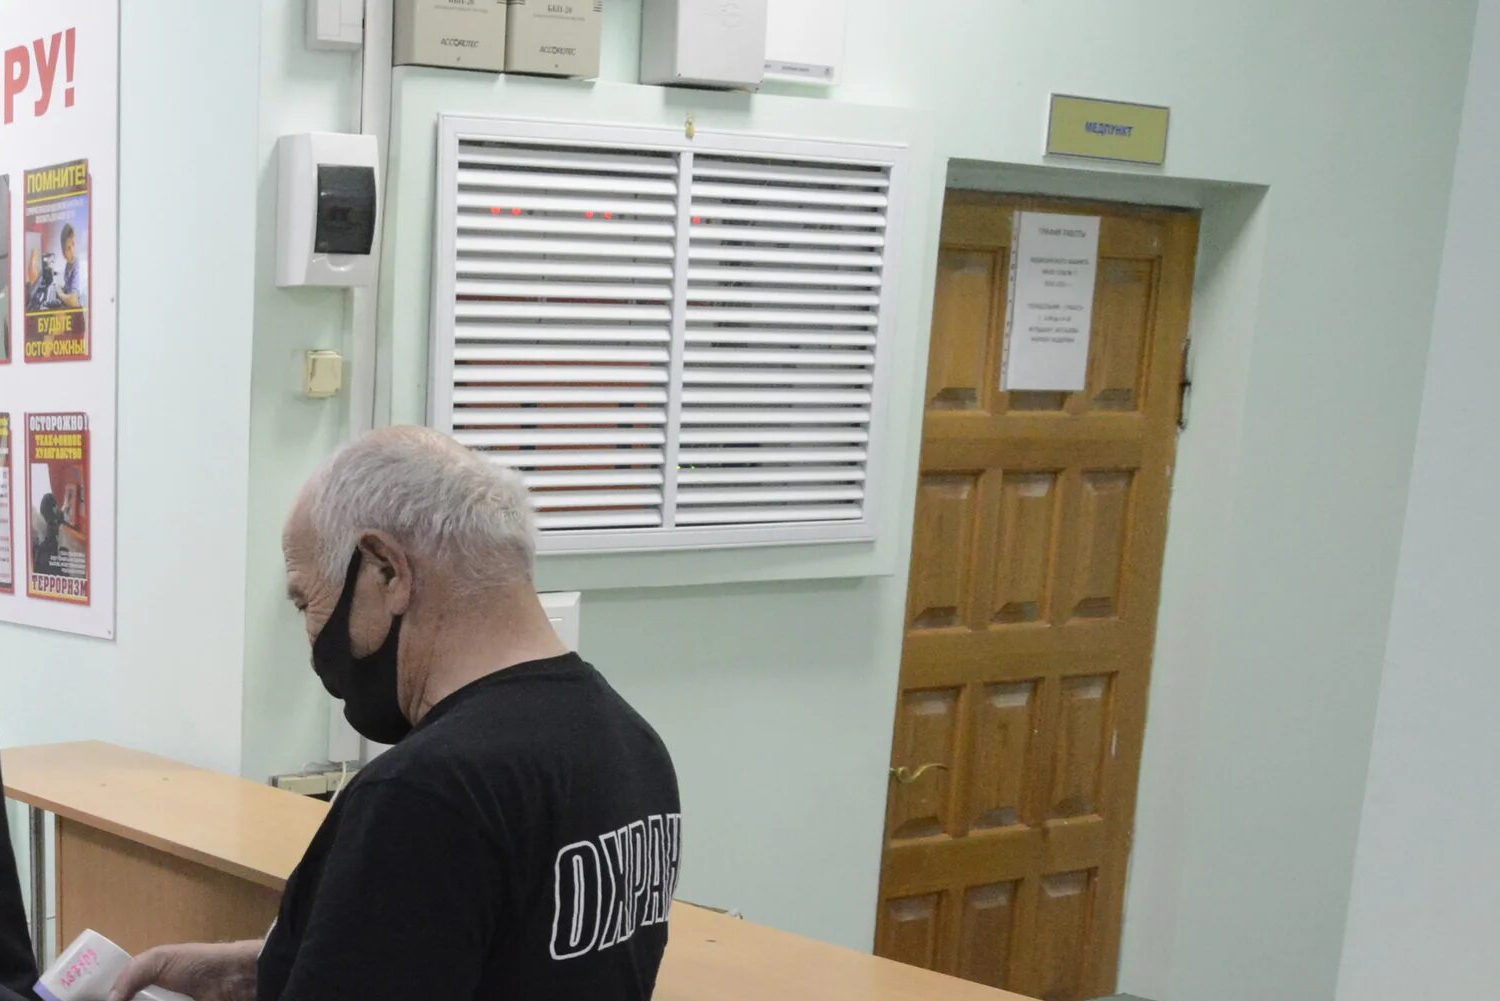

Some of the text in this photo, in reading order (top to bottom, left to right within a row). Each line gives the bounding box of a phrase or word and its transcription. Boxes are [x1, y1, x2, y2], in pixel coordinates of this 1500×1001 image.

[1085, 121, 1134, 138] МЕДПУНКТ
[27, 163, 86, 194] ПОМНИТЕ!
[38, 315, 72, 334] БУДЬТЕ
[26, 339, 86, 357] ОСТОРОЖНЫ!
[30, 414, 88, 431] ОСТОРОЖНО!
[32, 574, 88, 597] ТЕРРОРИЗМ
